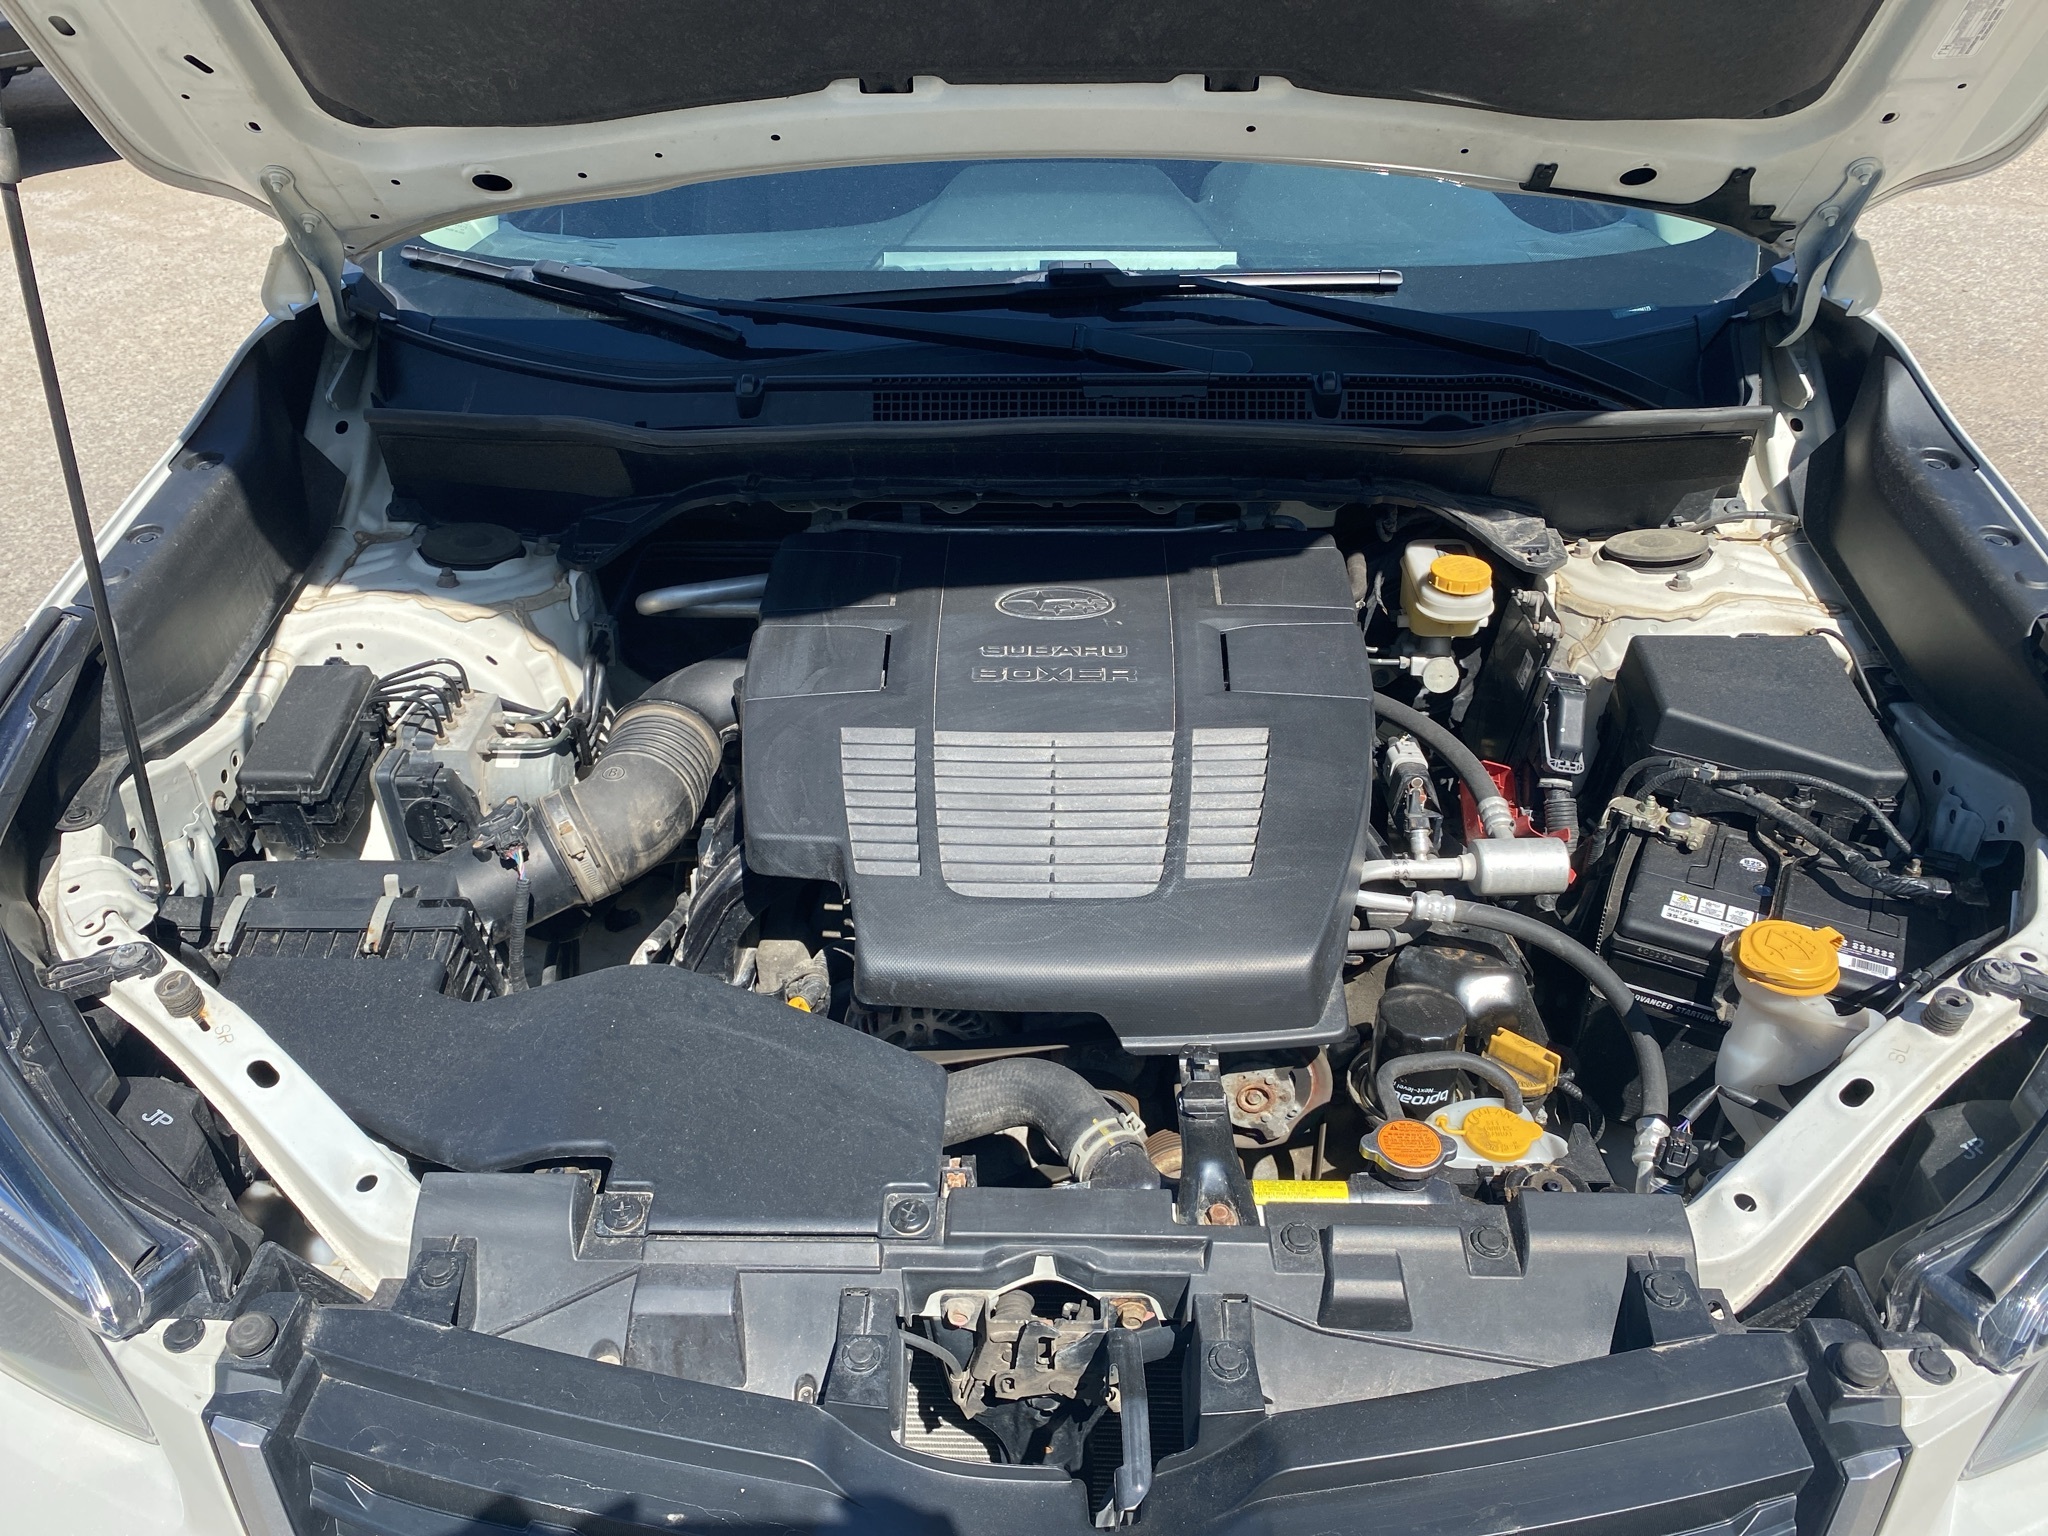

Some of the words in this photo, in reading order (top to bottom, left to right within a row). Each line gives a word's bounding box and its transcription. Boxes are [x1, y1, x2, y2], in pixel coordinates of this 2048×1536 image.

[979, 645, 1128, 658] SUBARU
[971, 667, 1138, 683] BOXER
[1633, 992, 1674, 1011] DVANCED
[1675, 1005, 1717, 1023] STARTING
[214, 1024, 235, 1046] SR
[142, 1108, 174, 1126] JP
